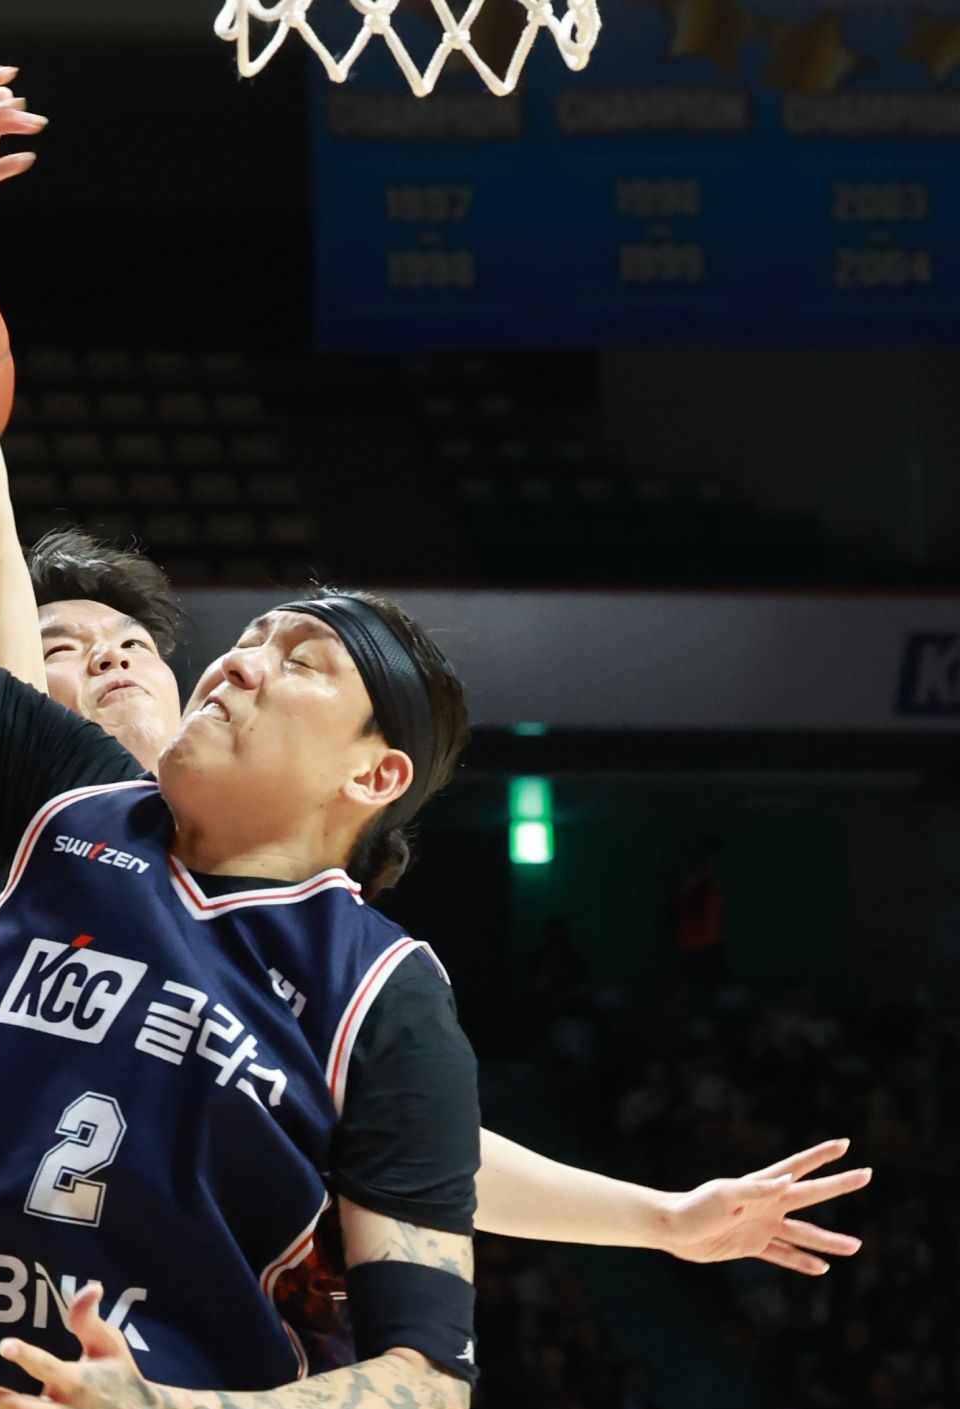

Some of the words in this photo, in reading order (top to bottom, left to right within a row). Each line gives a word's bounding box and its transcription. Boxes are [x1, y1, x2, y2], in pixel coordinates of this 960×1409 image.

[9, 934, 123, 1030] KCC
[135, 980, 287, 1112] 글라스
[24, 1091, 127, 1228] 2
